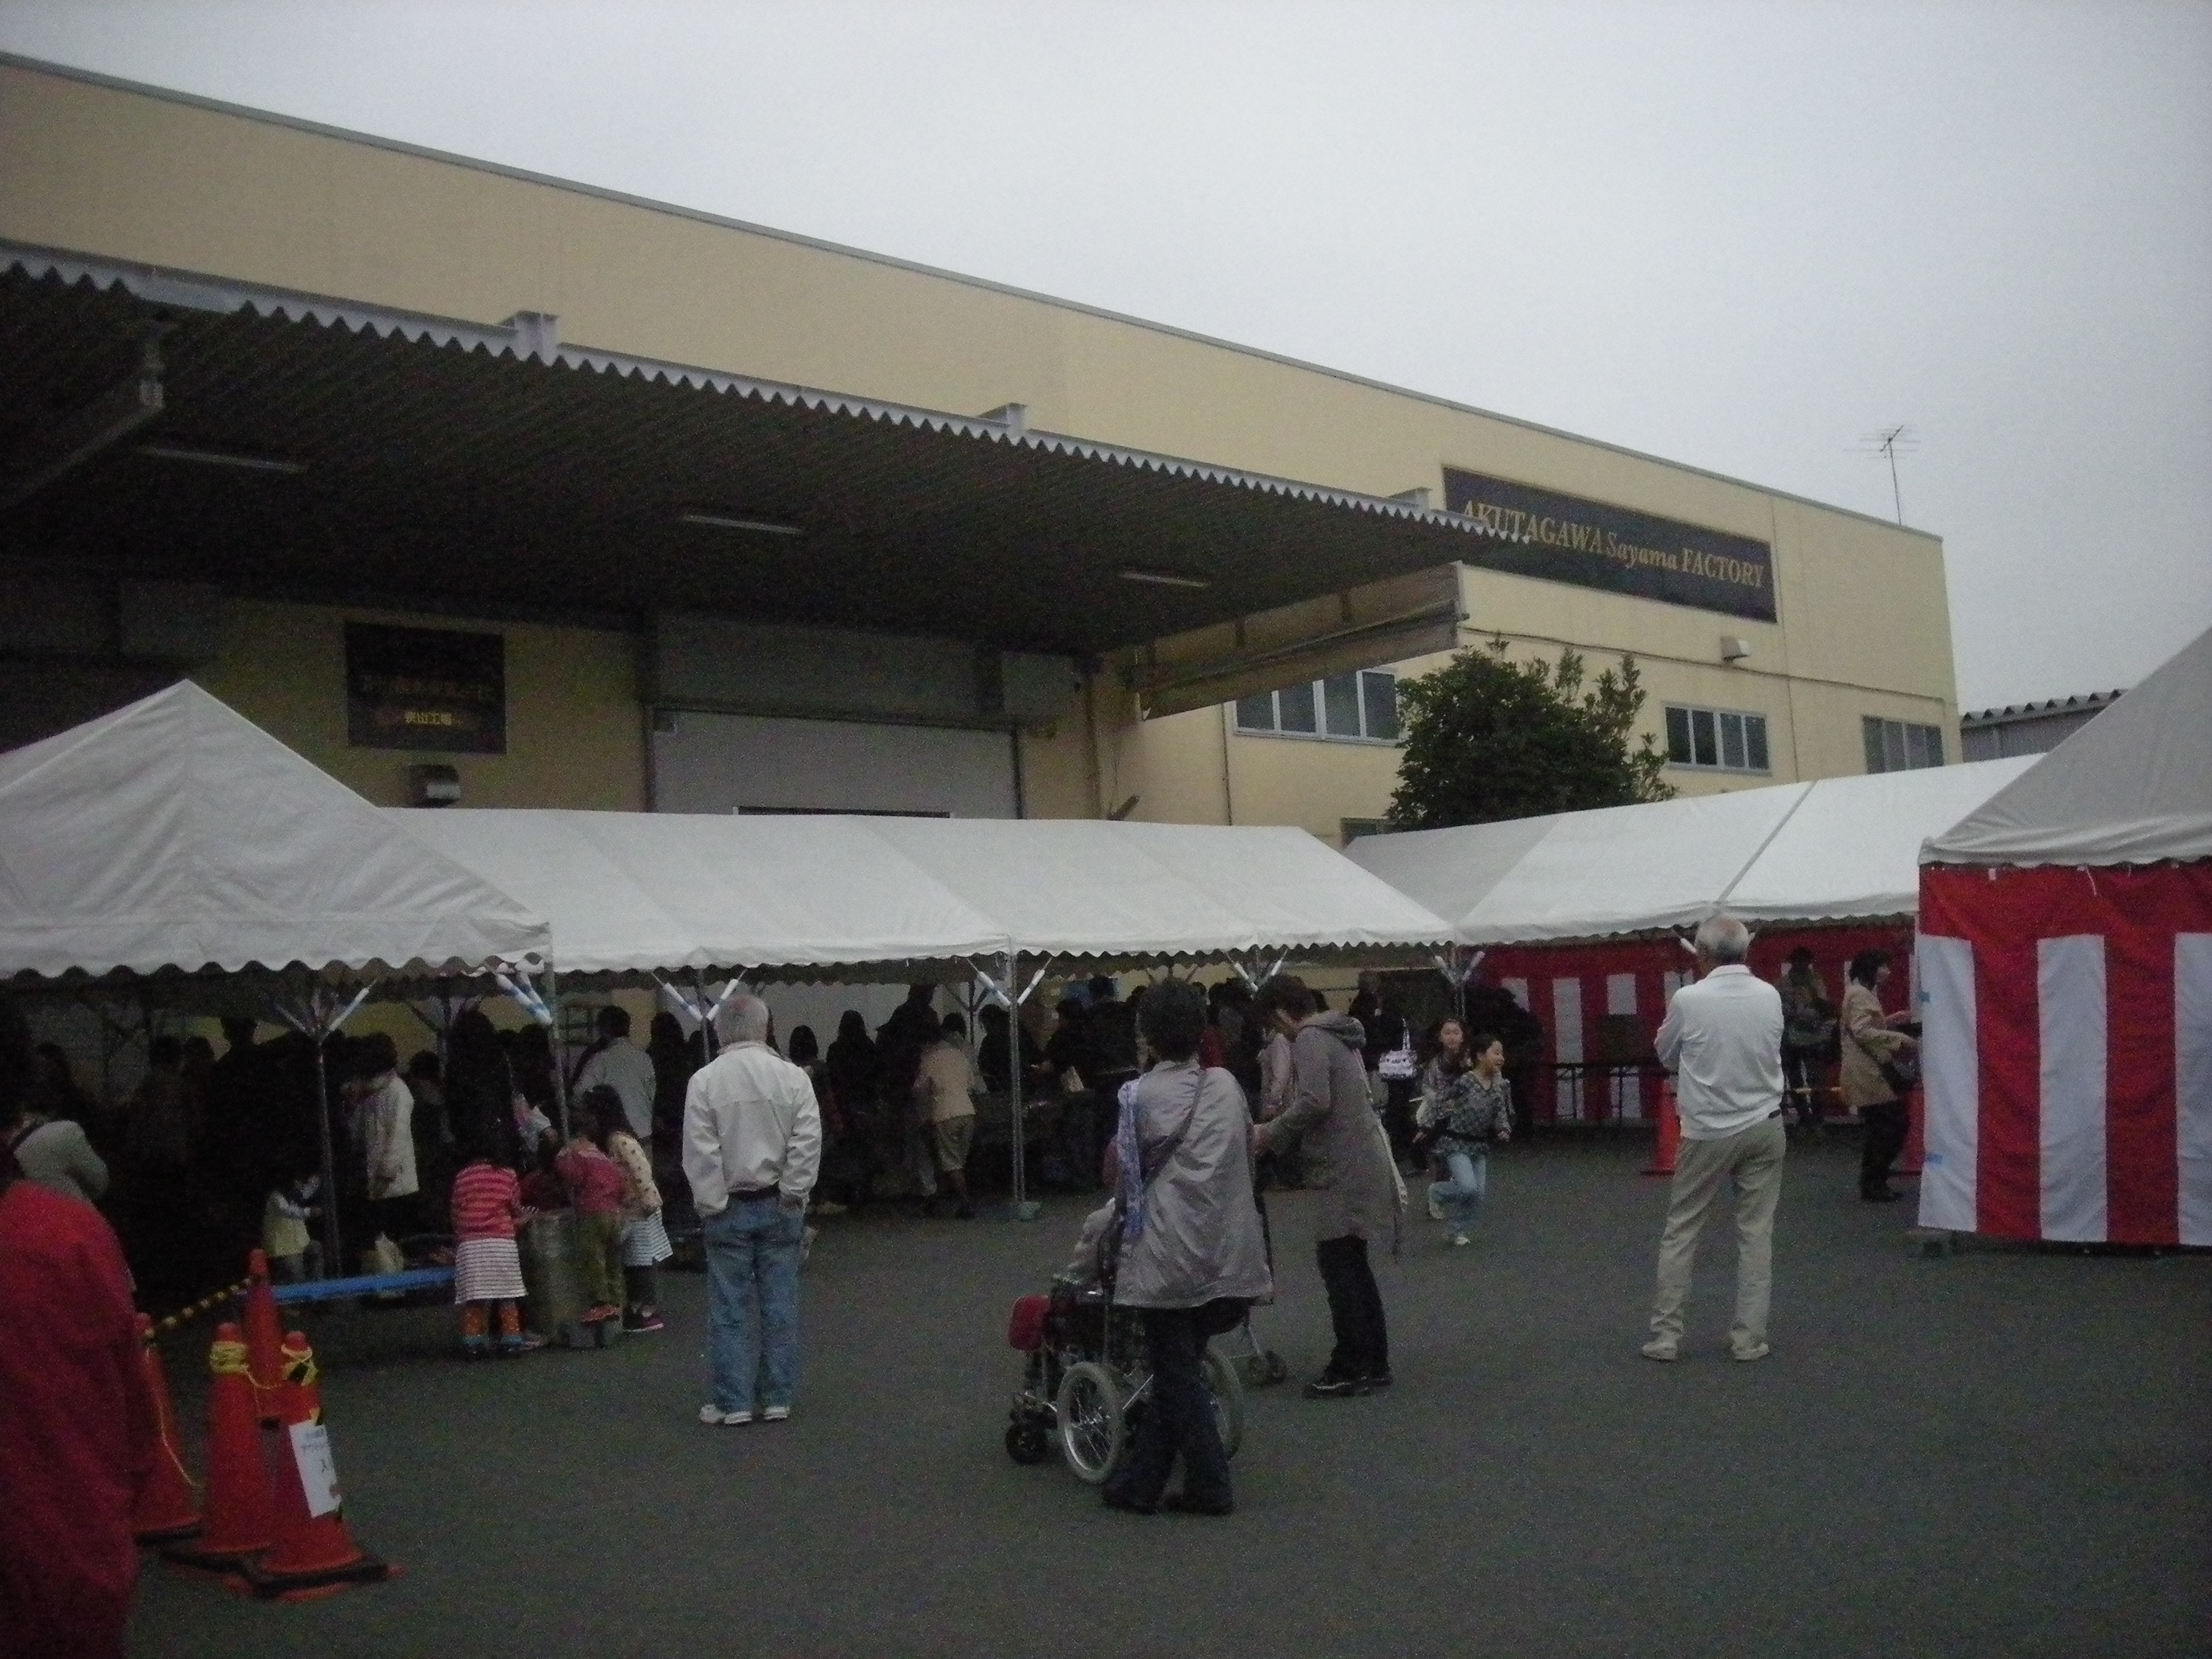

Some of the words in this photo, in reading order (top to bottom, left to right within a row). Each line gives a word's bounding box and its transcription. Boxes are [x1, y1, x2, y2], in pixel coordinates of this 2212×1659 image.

[1464, 499, 1602, 554] AKUTAGAWA
[1607, 531, 1678, 568] Sayama
[1682, 546, 1764, 588] FACTORY
